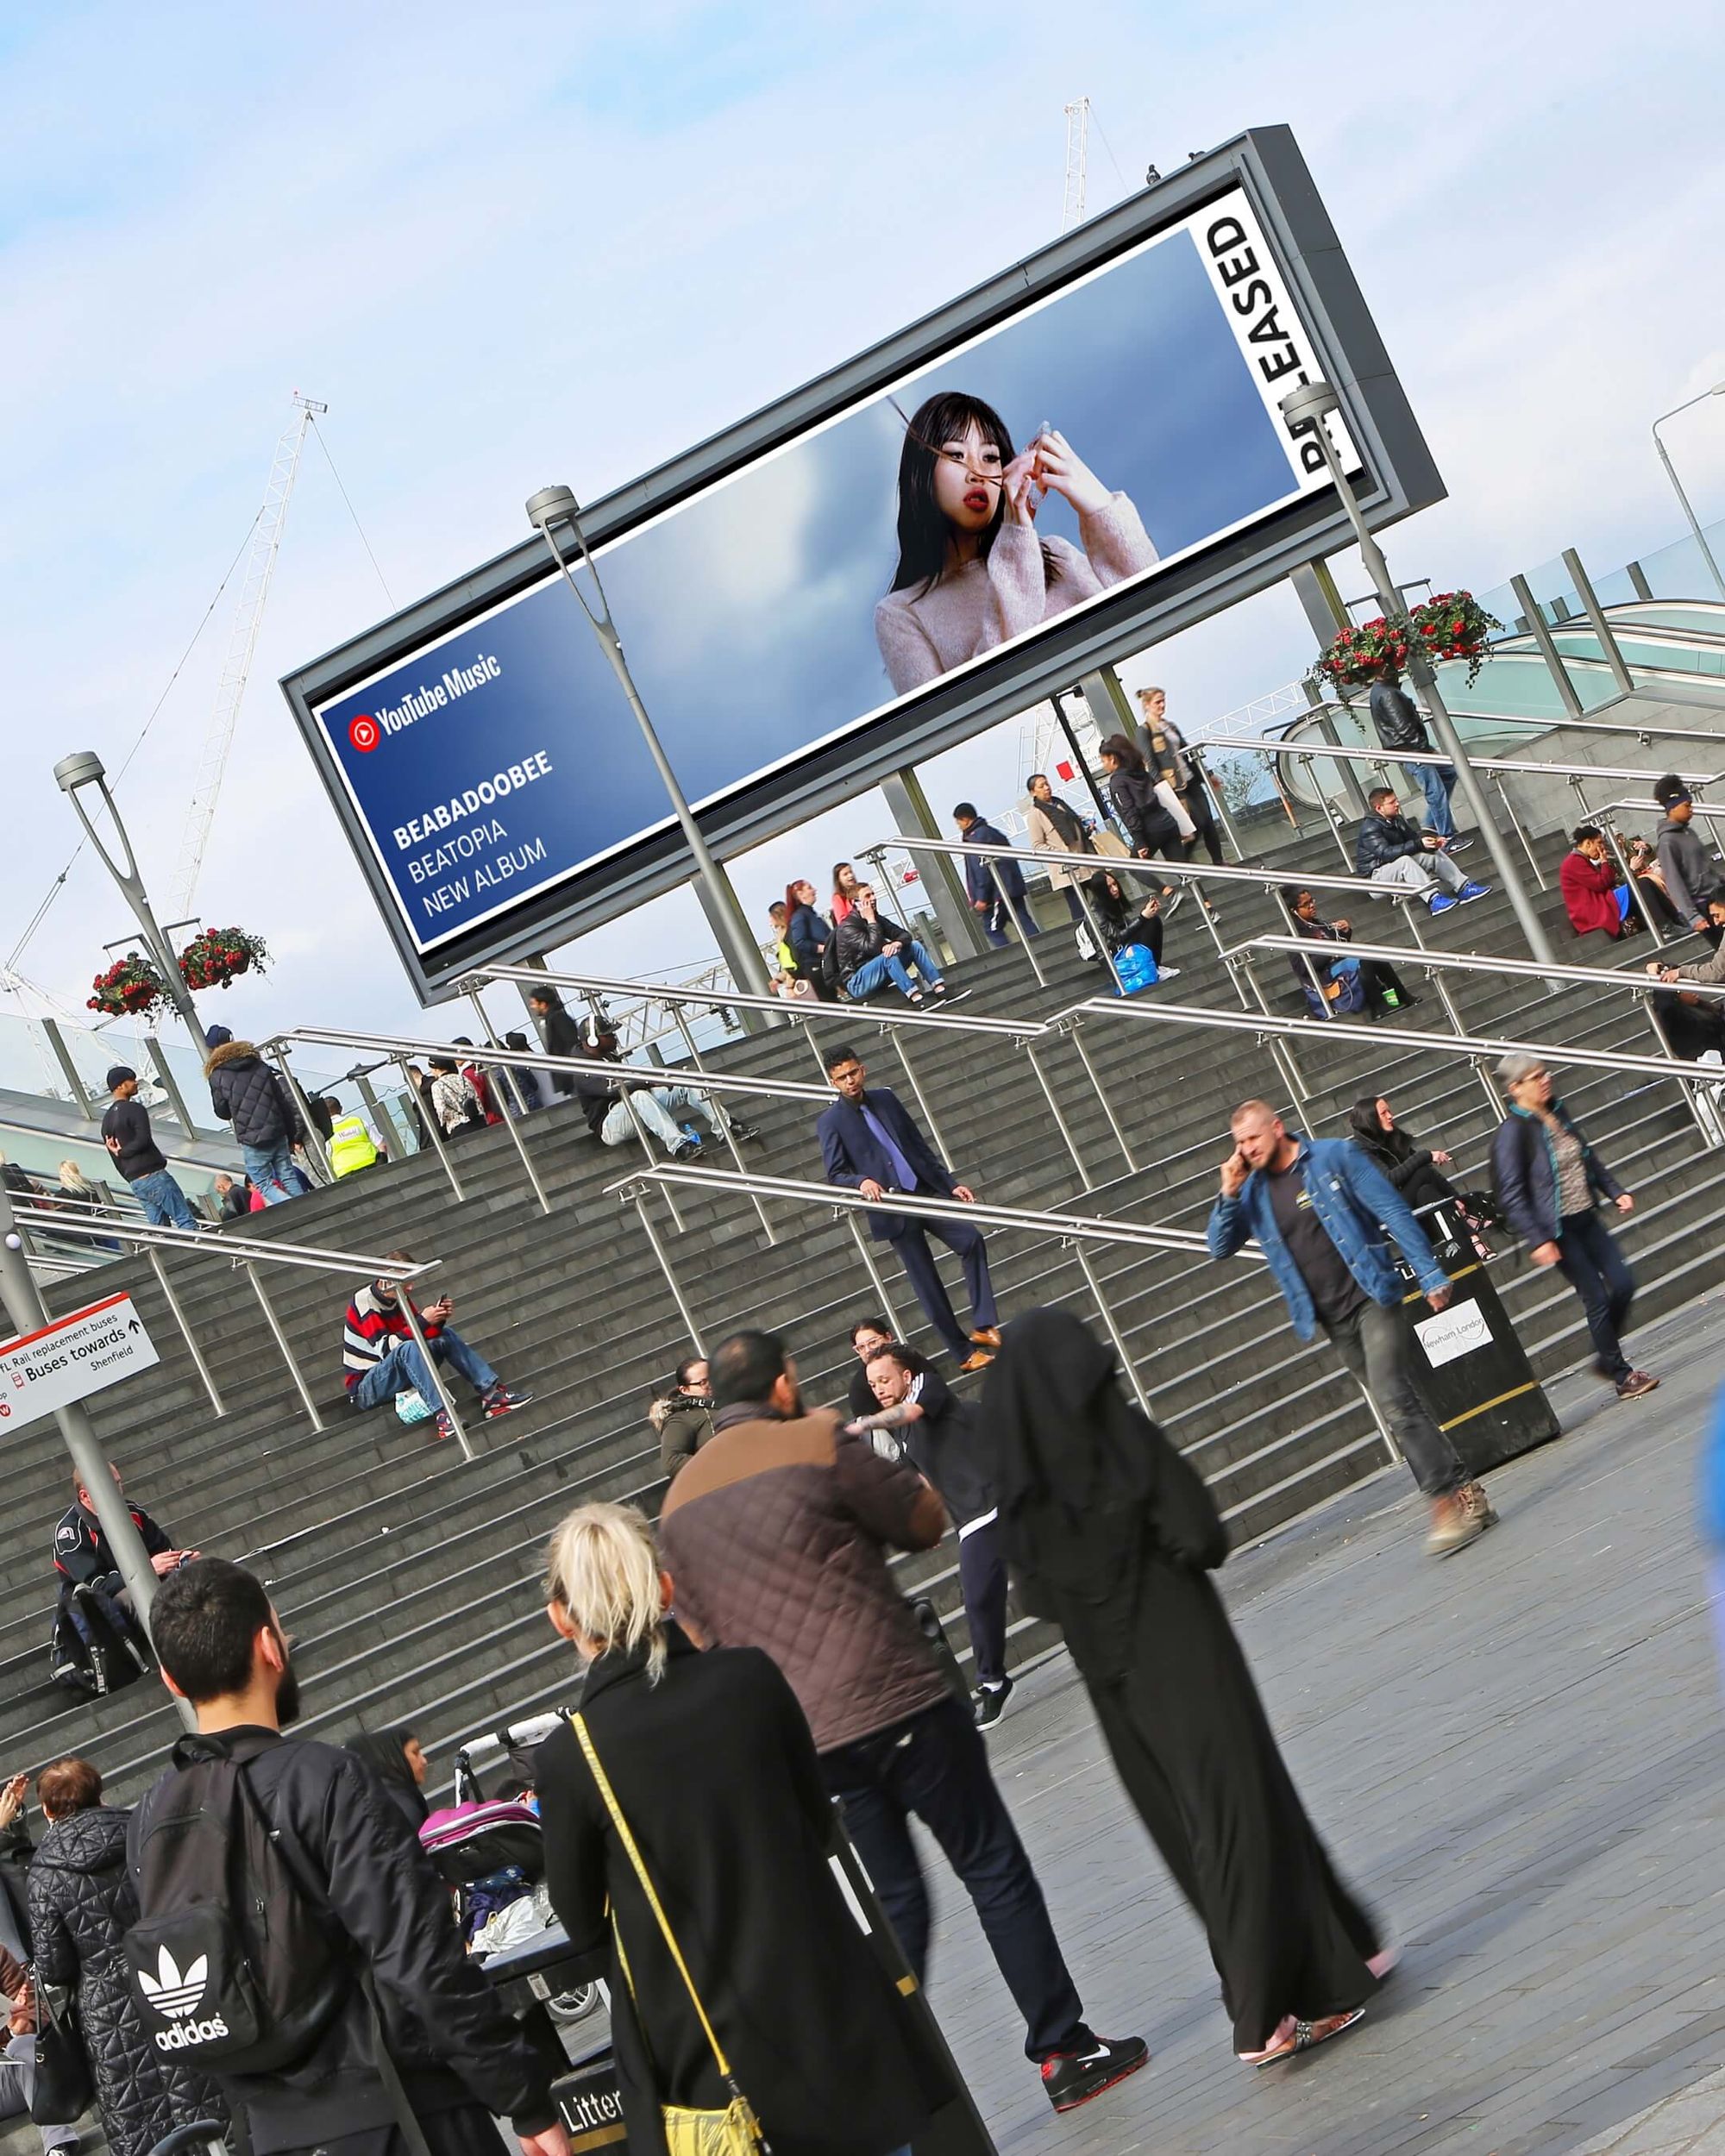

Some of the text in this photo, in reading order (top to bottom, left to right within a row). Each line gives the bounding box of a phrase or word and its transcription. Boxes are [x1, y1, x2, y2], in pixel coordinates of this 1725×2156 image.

[1207, 216, 1342, 474] REASED
[375, 654, 502, 736] YouTube Music
[392, 750, 553, 850] BEABADOOBEE
[407, 818, 508, 884] BEATOPIA
[422, 837, 548, 918] NEW ALBUM
[0, 1314, 118, 1373] fL Rail replacement buses
[25, 1329, 126, 1382] Buses towards
[90, 1345, 134, 1371] Shenfield
[1423, 1317, 1484, 1351] Newham London
[155, 2016, 229, 2051] adidas
[560, 2090, 624, 2132] Litter
